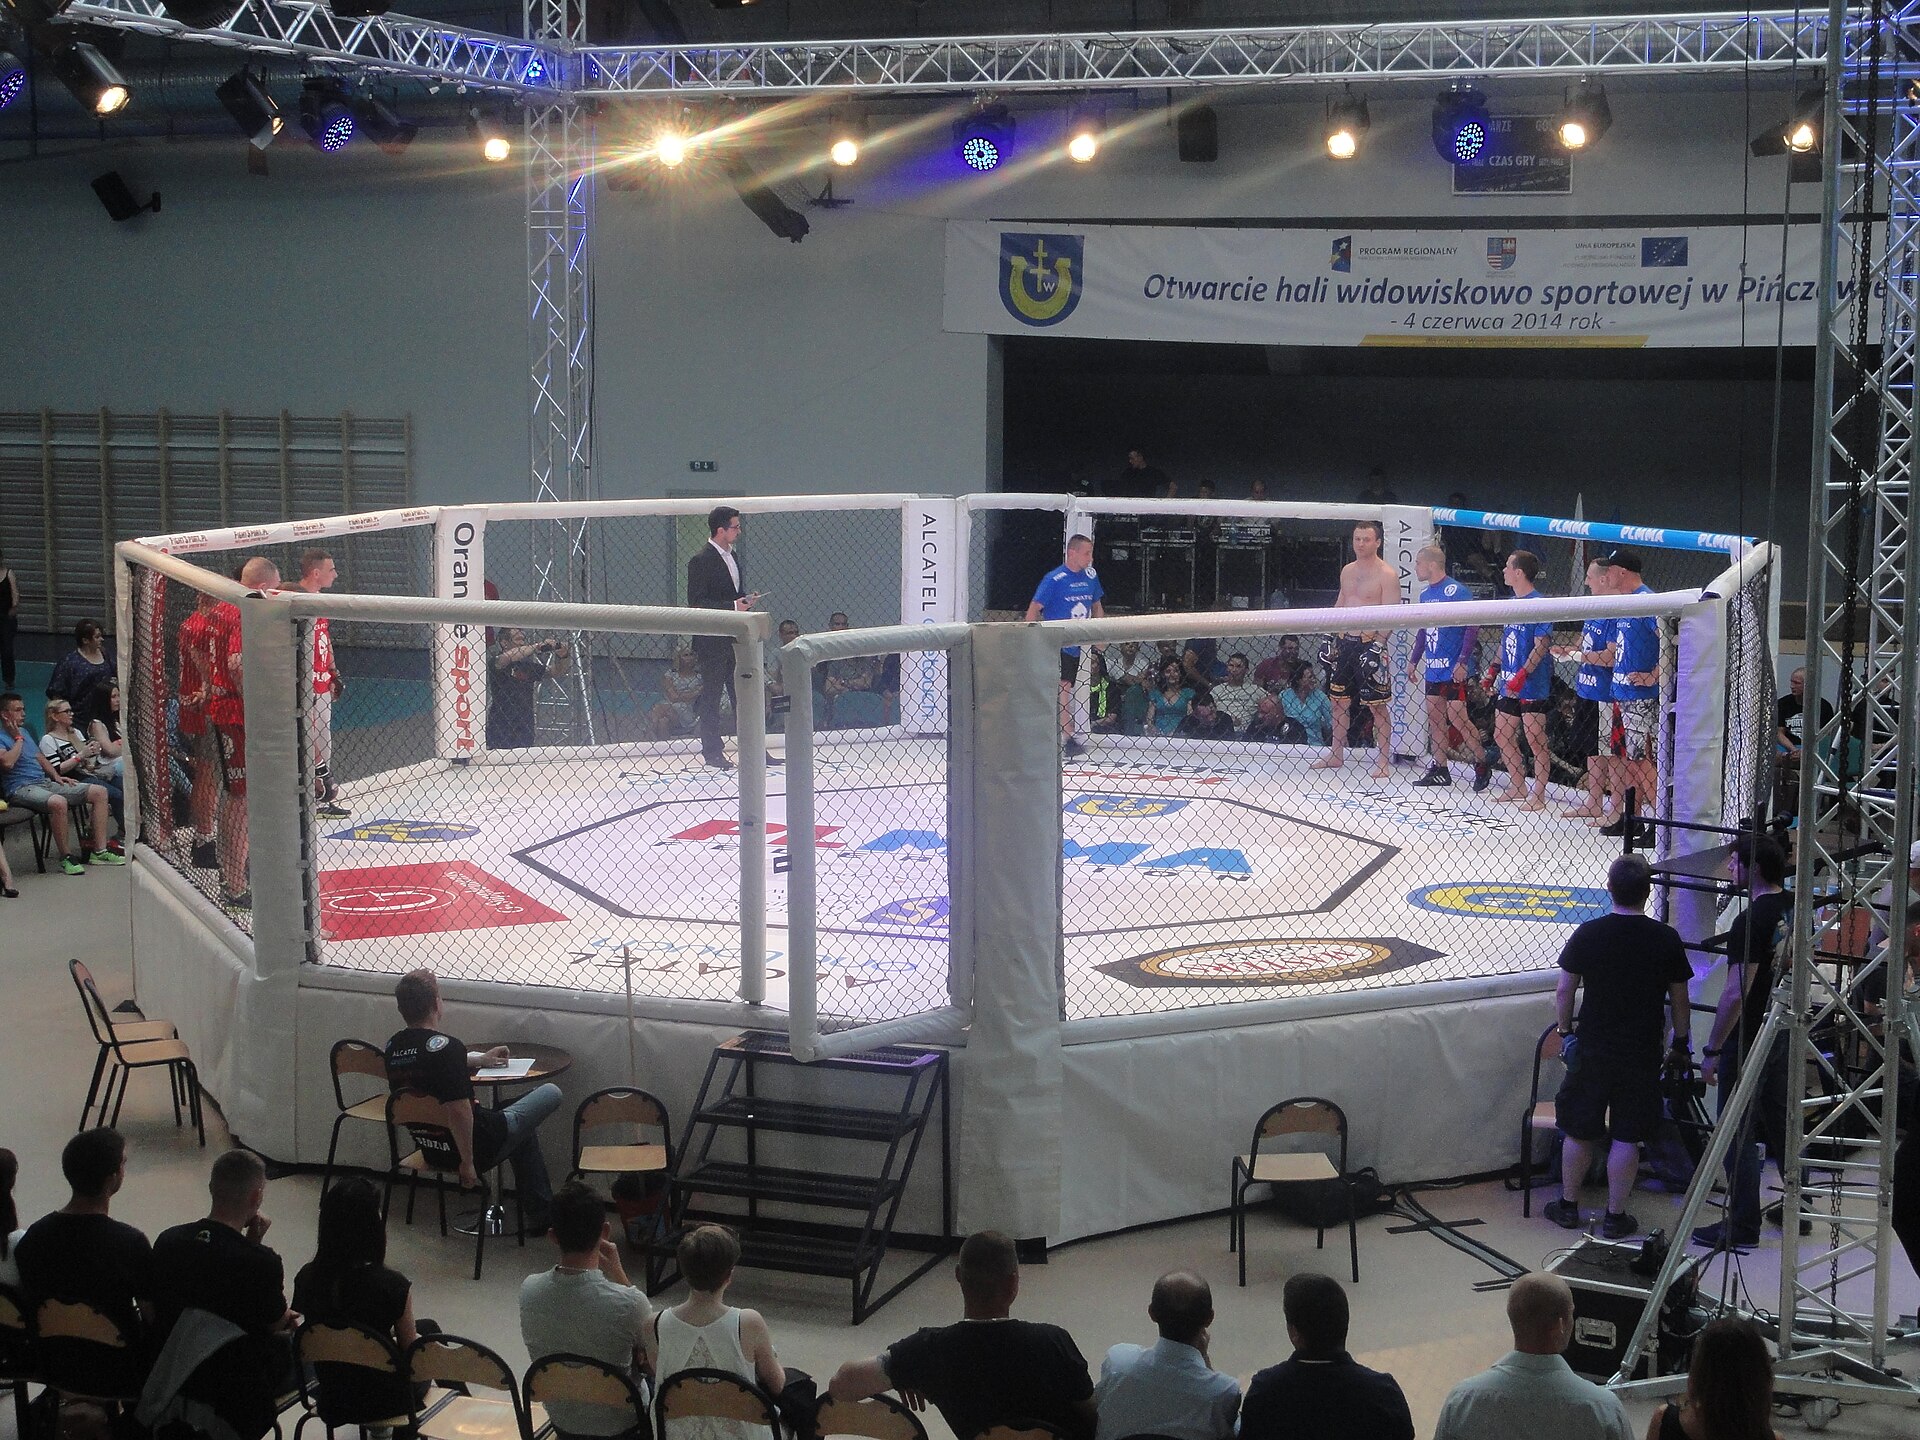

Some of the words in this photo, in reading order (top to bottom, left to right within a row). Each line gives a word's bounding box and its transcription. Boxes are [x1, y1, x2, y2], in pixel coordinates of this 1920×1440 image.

[1488, 156, 1513, 166] CZAS
[1515, 155, 1536, 166] GRY
[1359, 247, 1402, 256] PROGRAM
[1403, 247, 1459, 256] REGIONALNY
[1143, 274, 1268, 302] Otwarcie
[1276, 276, 1329, 303] hali
[1337, 277, 1533, 305] widowiskowo
[1540, 276, 1694, 311] sportowej
[1700, 283, 1729, 301] w
[1403, 312, 1416, 329] 4
[1421, 316, 1504, 330] czerwca
[1510, 312, 1562, 330] 2014
[1568, 312, 1602, 330] rok
[1482, 512, 1521, 528] PLMMA
[1548, 519, 1590, 535] PLMMA
[1619, 526, 1665, 543] PLMMA
[1697, 532, 1732, 549] PLMM
[921, 513, 938, 612] ALCATEL
[450, 645, 476, 751] sport
[392, 1047, 419, 1057] ALCATEL
